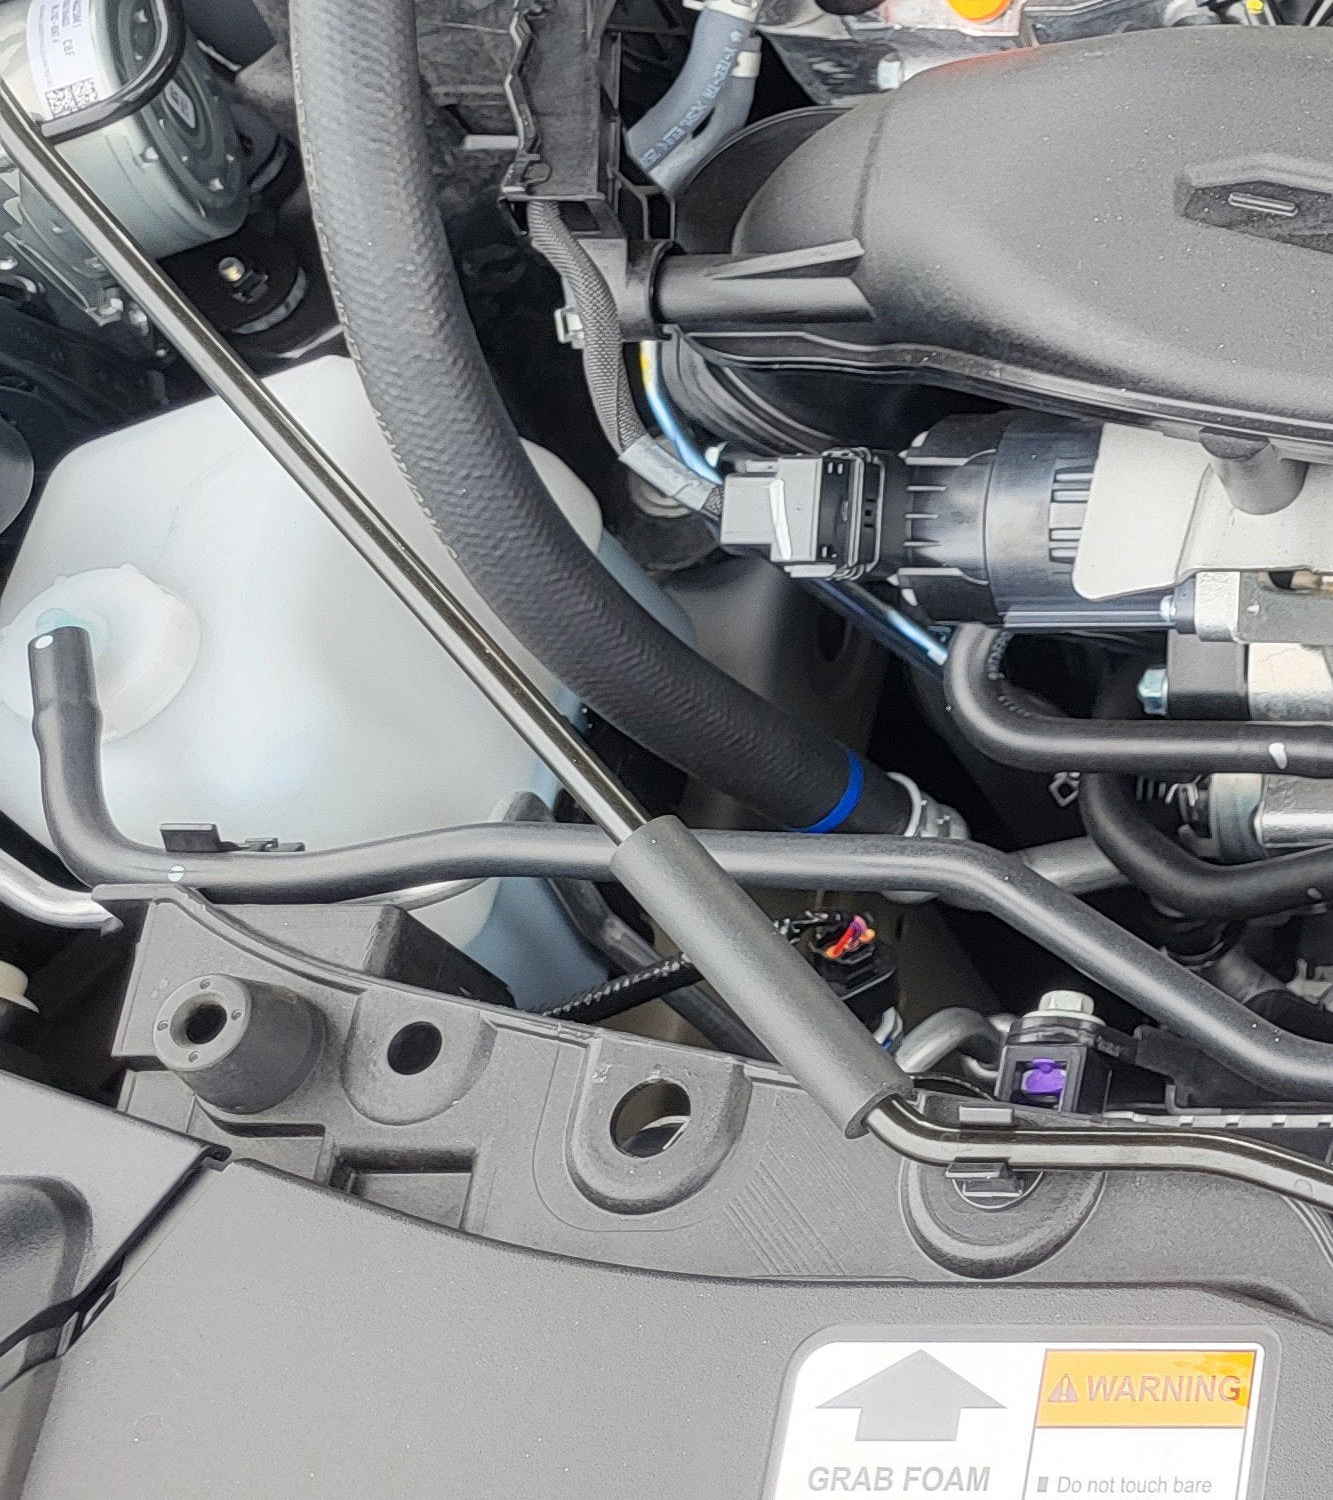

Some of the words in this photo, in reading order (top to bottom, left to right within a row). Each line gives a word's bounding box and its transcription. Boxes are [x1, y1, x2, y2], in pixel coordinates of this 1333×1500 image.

[62, 38, 75, 58] CBF
[1087, 1375, 1241, 1402] WARNING
[807, 1465, 895, 1493] GRAB
[903, 1465, 992, 1492] FOAM
[1057, 1476, 1083, 1493] Do
[1087, 1477, 1117, 1493] not
[1120, 1475, 1169, 1493] touch
[1173, 1475, 1213, 1493] bare
